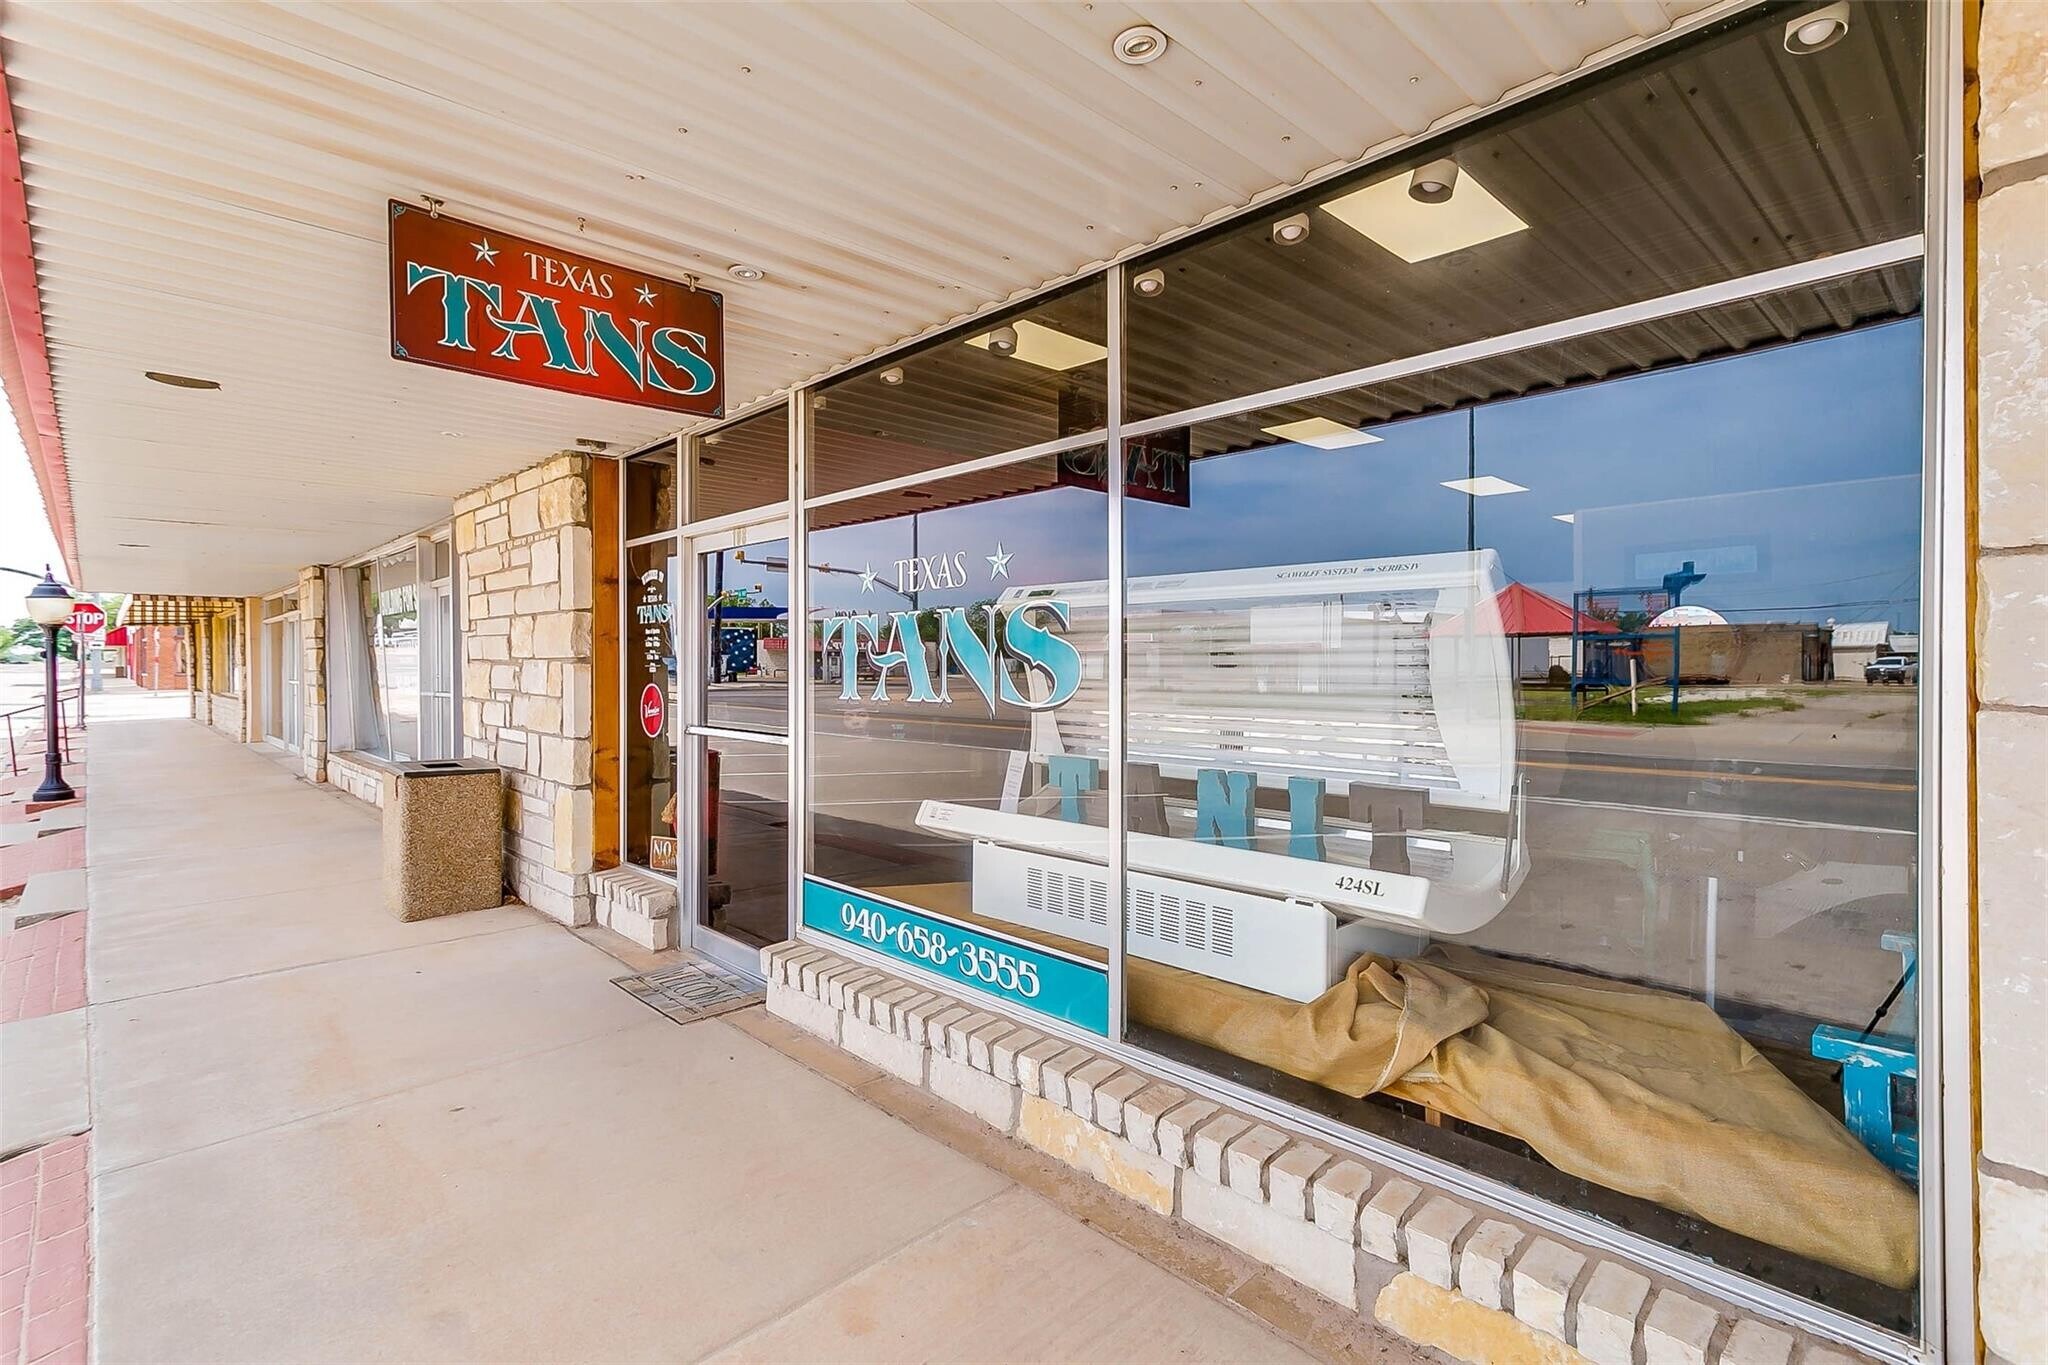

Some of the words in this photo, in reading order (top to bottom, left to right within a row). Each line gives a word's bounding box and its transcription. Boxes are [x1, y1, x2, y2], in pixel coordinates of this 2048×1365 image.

[523, 251, 615, 299] TEXAS
[407, 261, 716, 395] TANS
[893, 551, 968, 593] TEXAS
[65, 611, 105, 625] STOP
[636, 603, 672, 624] TANS
[823, 600, 1083, 720] TANS
[654, 840, 672, 857] NO
[1335, 876, 1386, 898] 424SL
[840, 902, 1041, 998] 940-658-3555
